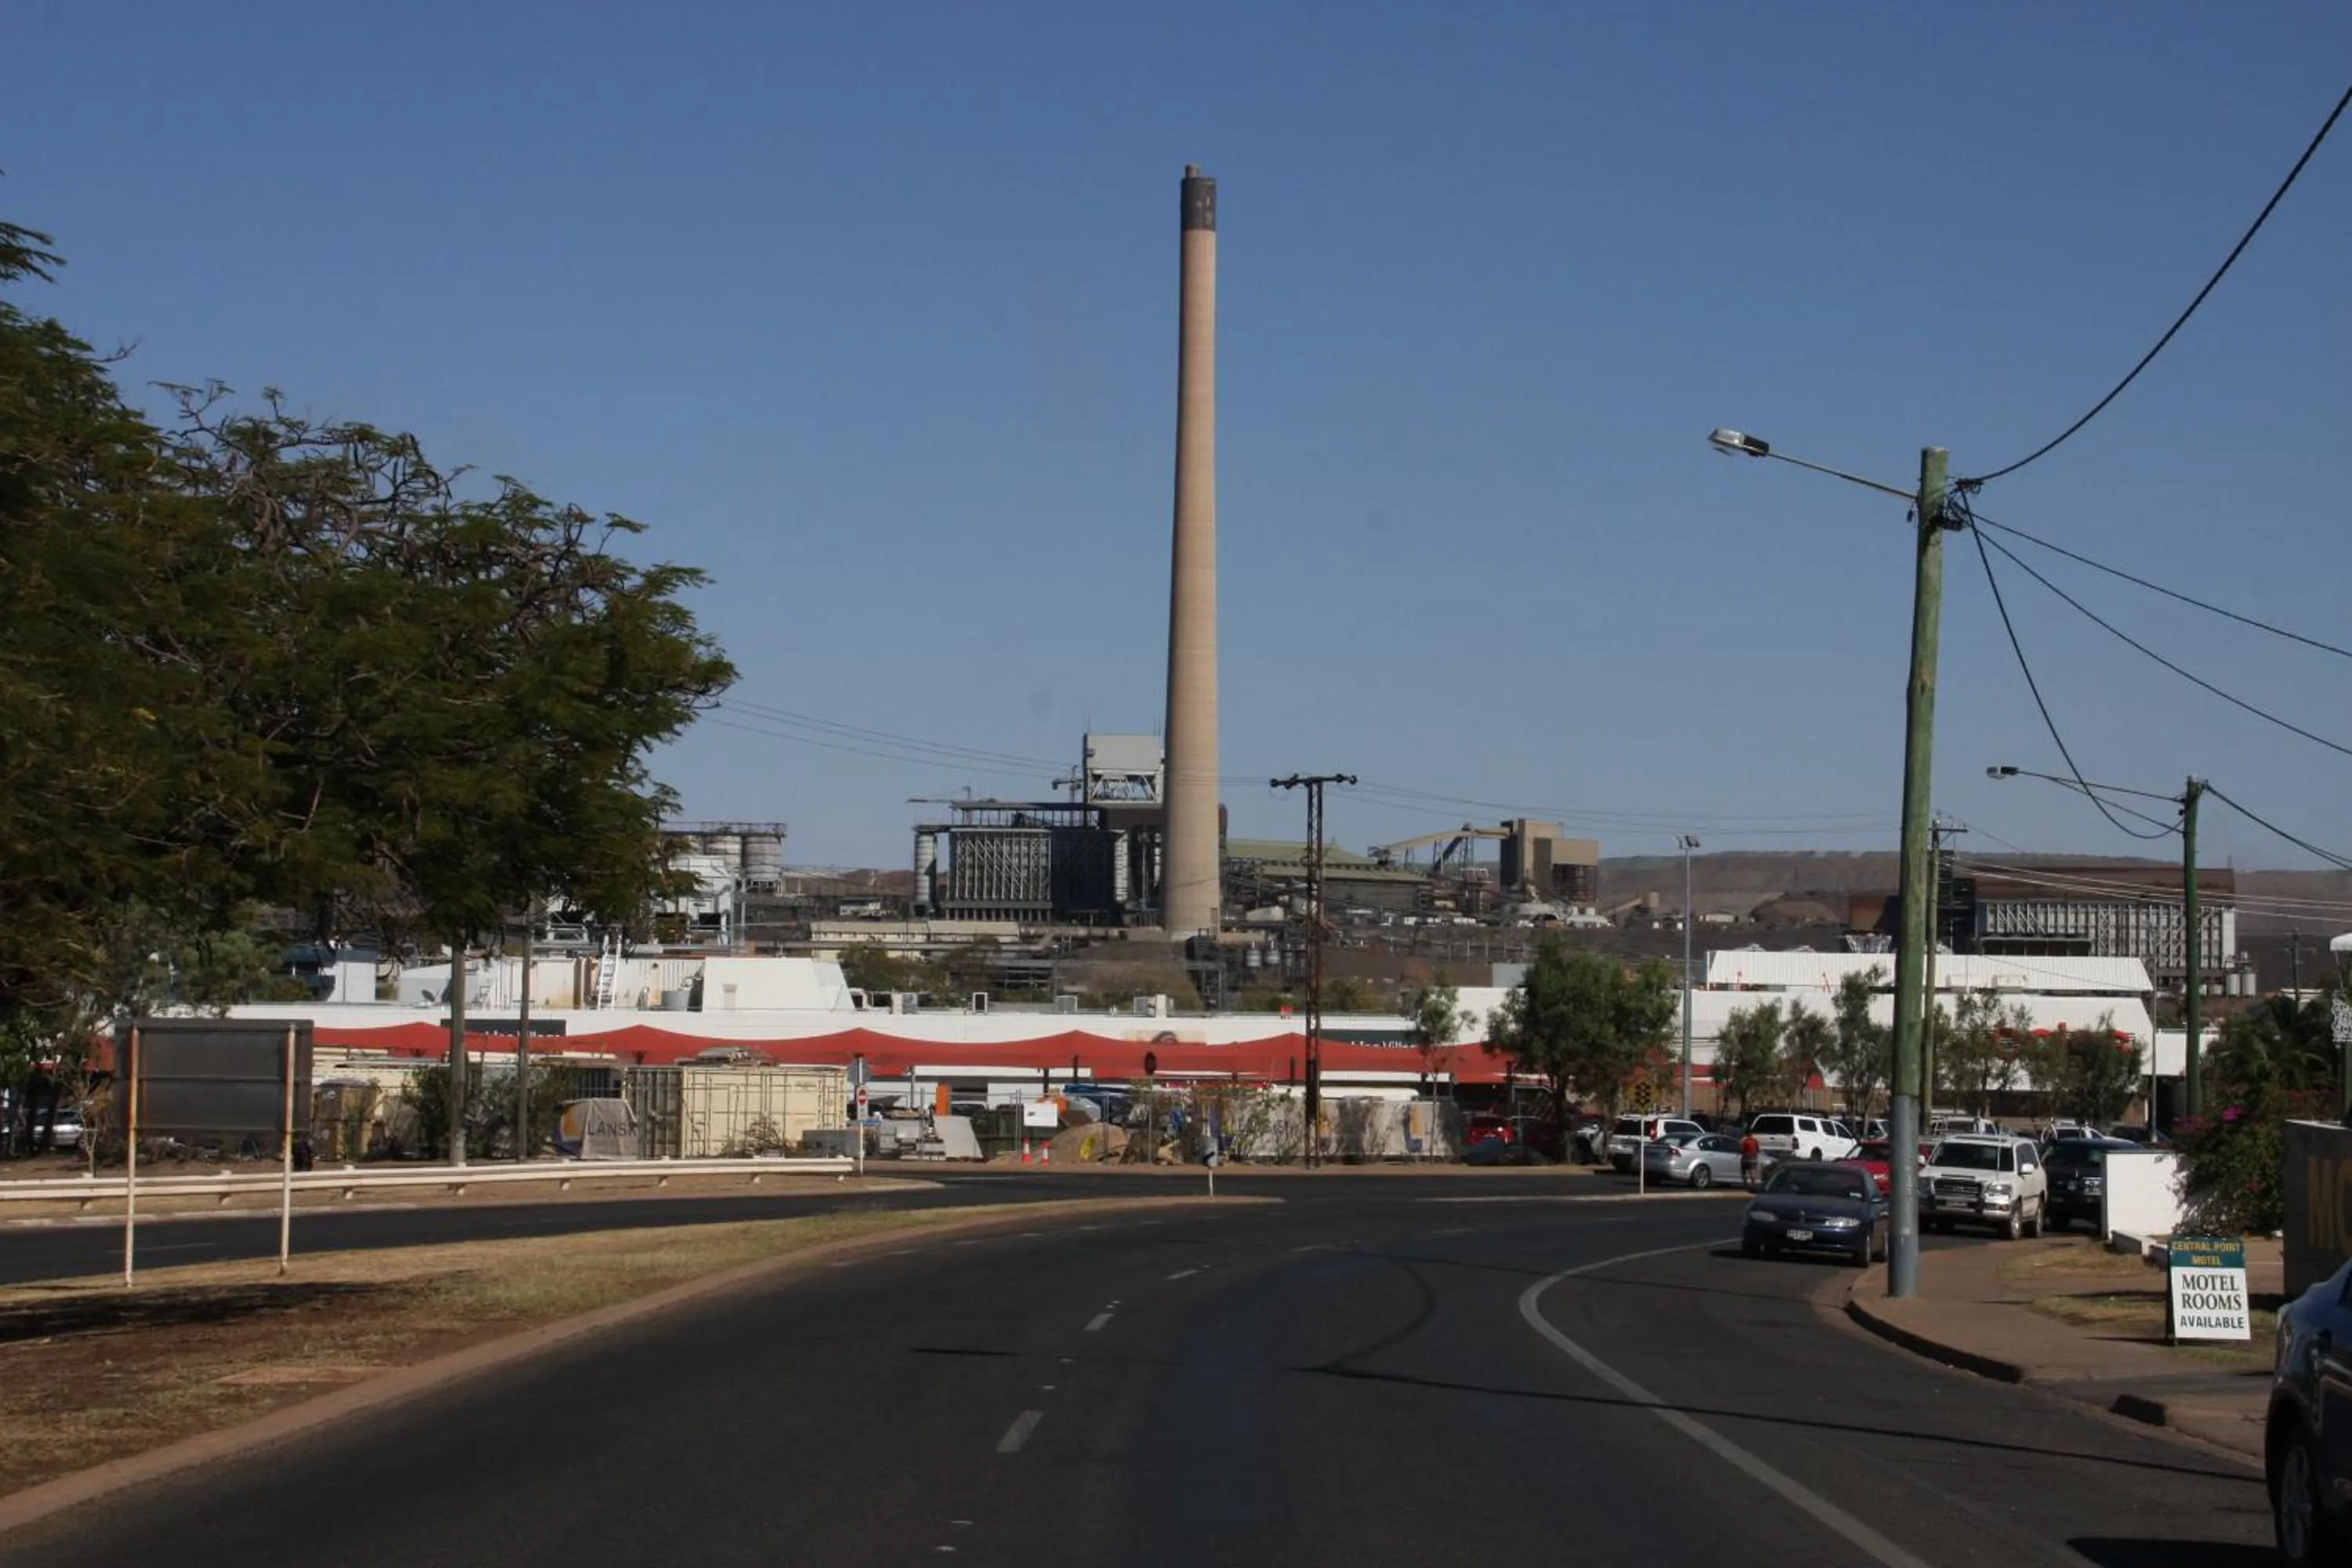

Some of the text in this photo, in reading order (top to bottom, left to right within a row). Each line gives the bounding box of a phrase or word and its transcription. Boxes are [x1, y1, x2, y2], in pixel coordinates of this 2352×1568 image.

[2192, 1255, 2222, 1265] MOTEL
[2182, 1274, 2240, 1292] MOTEL
[2182, 1294, 2242, 1311] ROOMS
[2180, 1314, 2245, 1330] AVAILABLE
